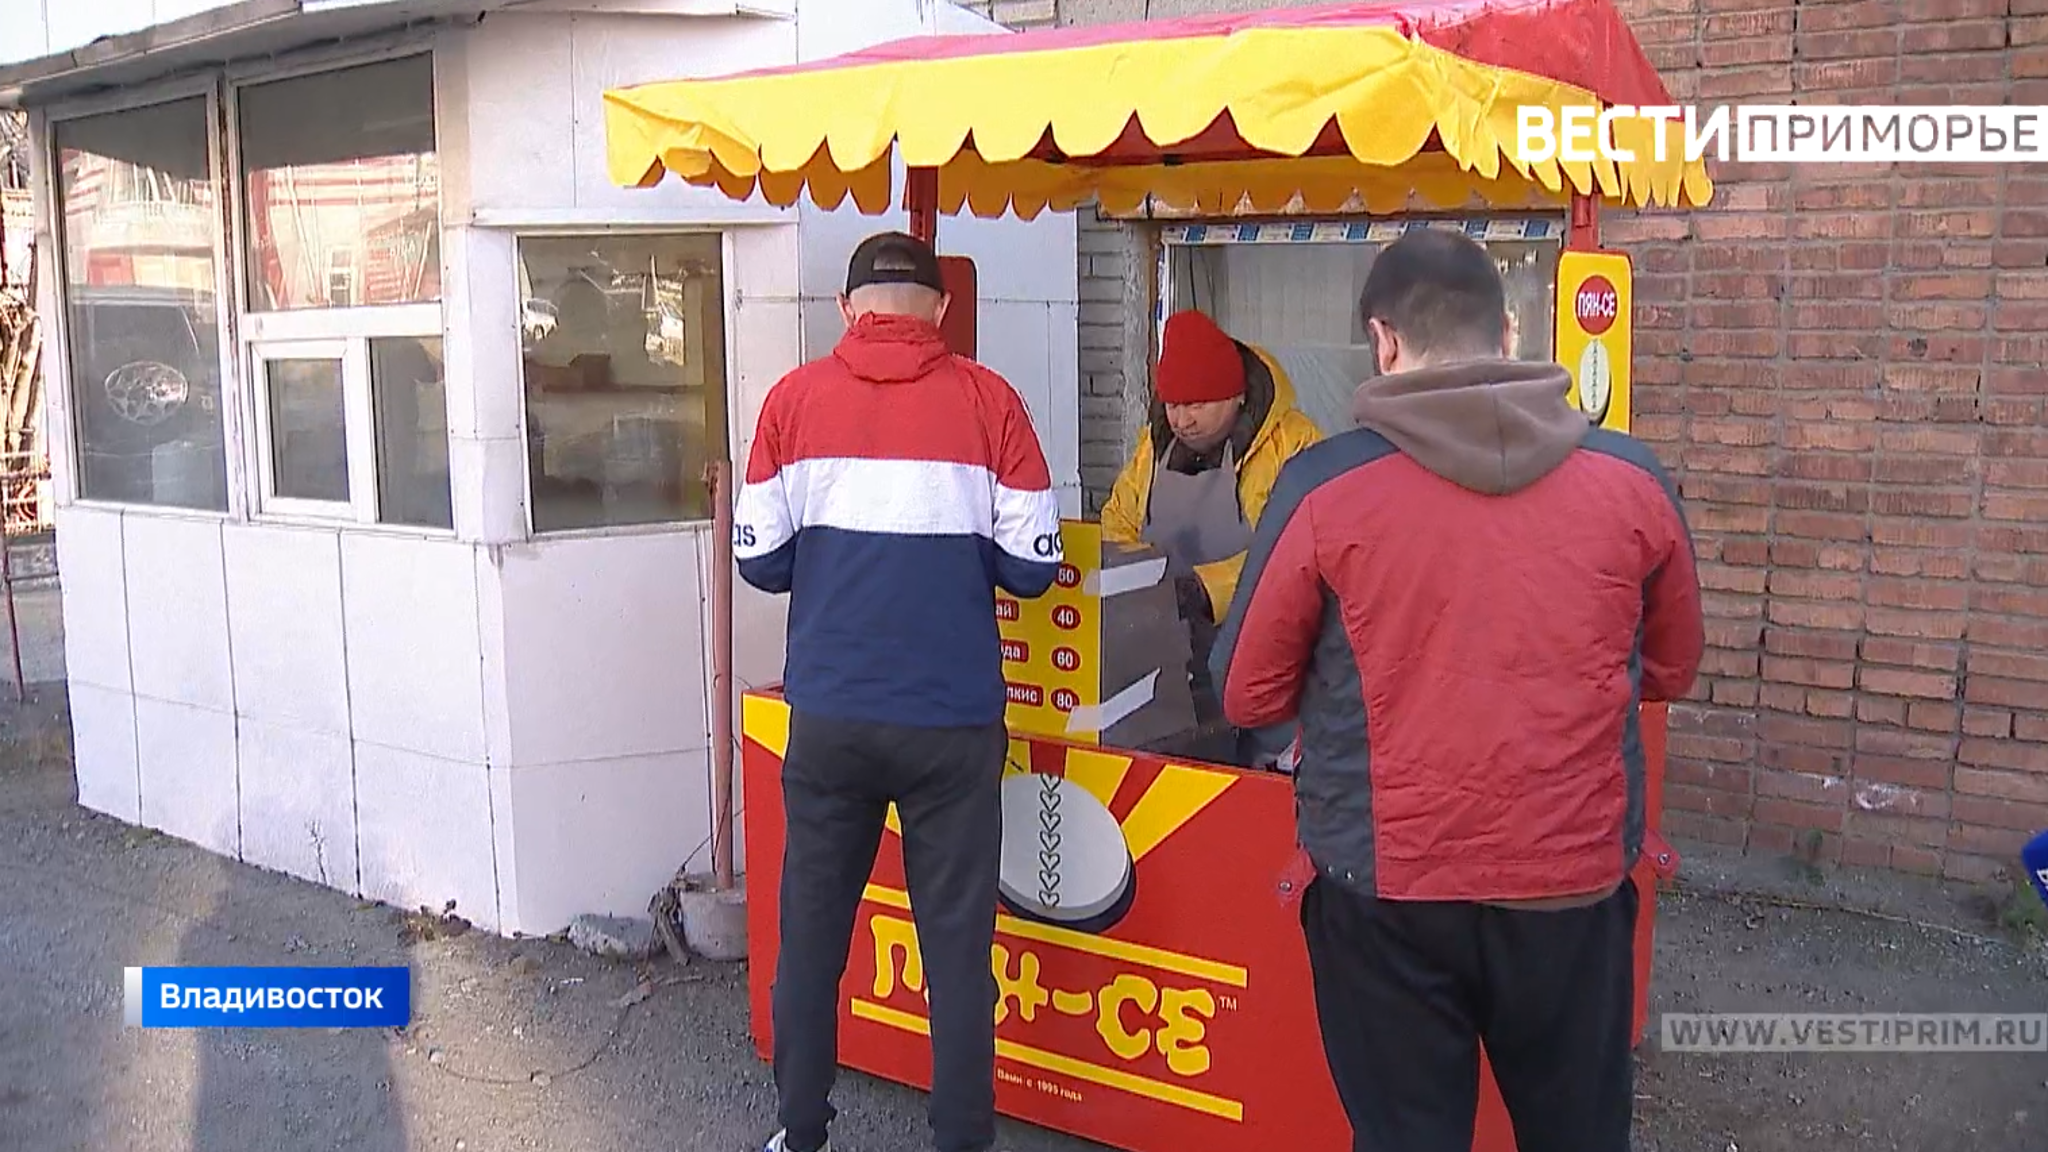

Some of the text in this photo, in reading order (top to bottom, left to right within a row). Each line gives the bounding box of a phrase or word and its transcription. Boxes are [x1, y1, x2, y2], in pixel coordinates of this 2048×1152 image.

[1577, 291, 1616, 319] ПЯН-СЕ
[995, 602, 1075, 626] ай 40
[1057, 650, 1075, 669] 60
[1056, 691, 1074, 710] 80
[870, 913, 1217, 1077] ПН-СЕ
